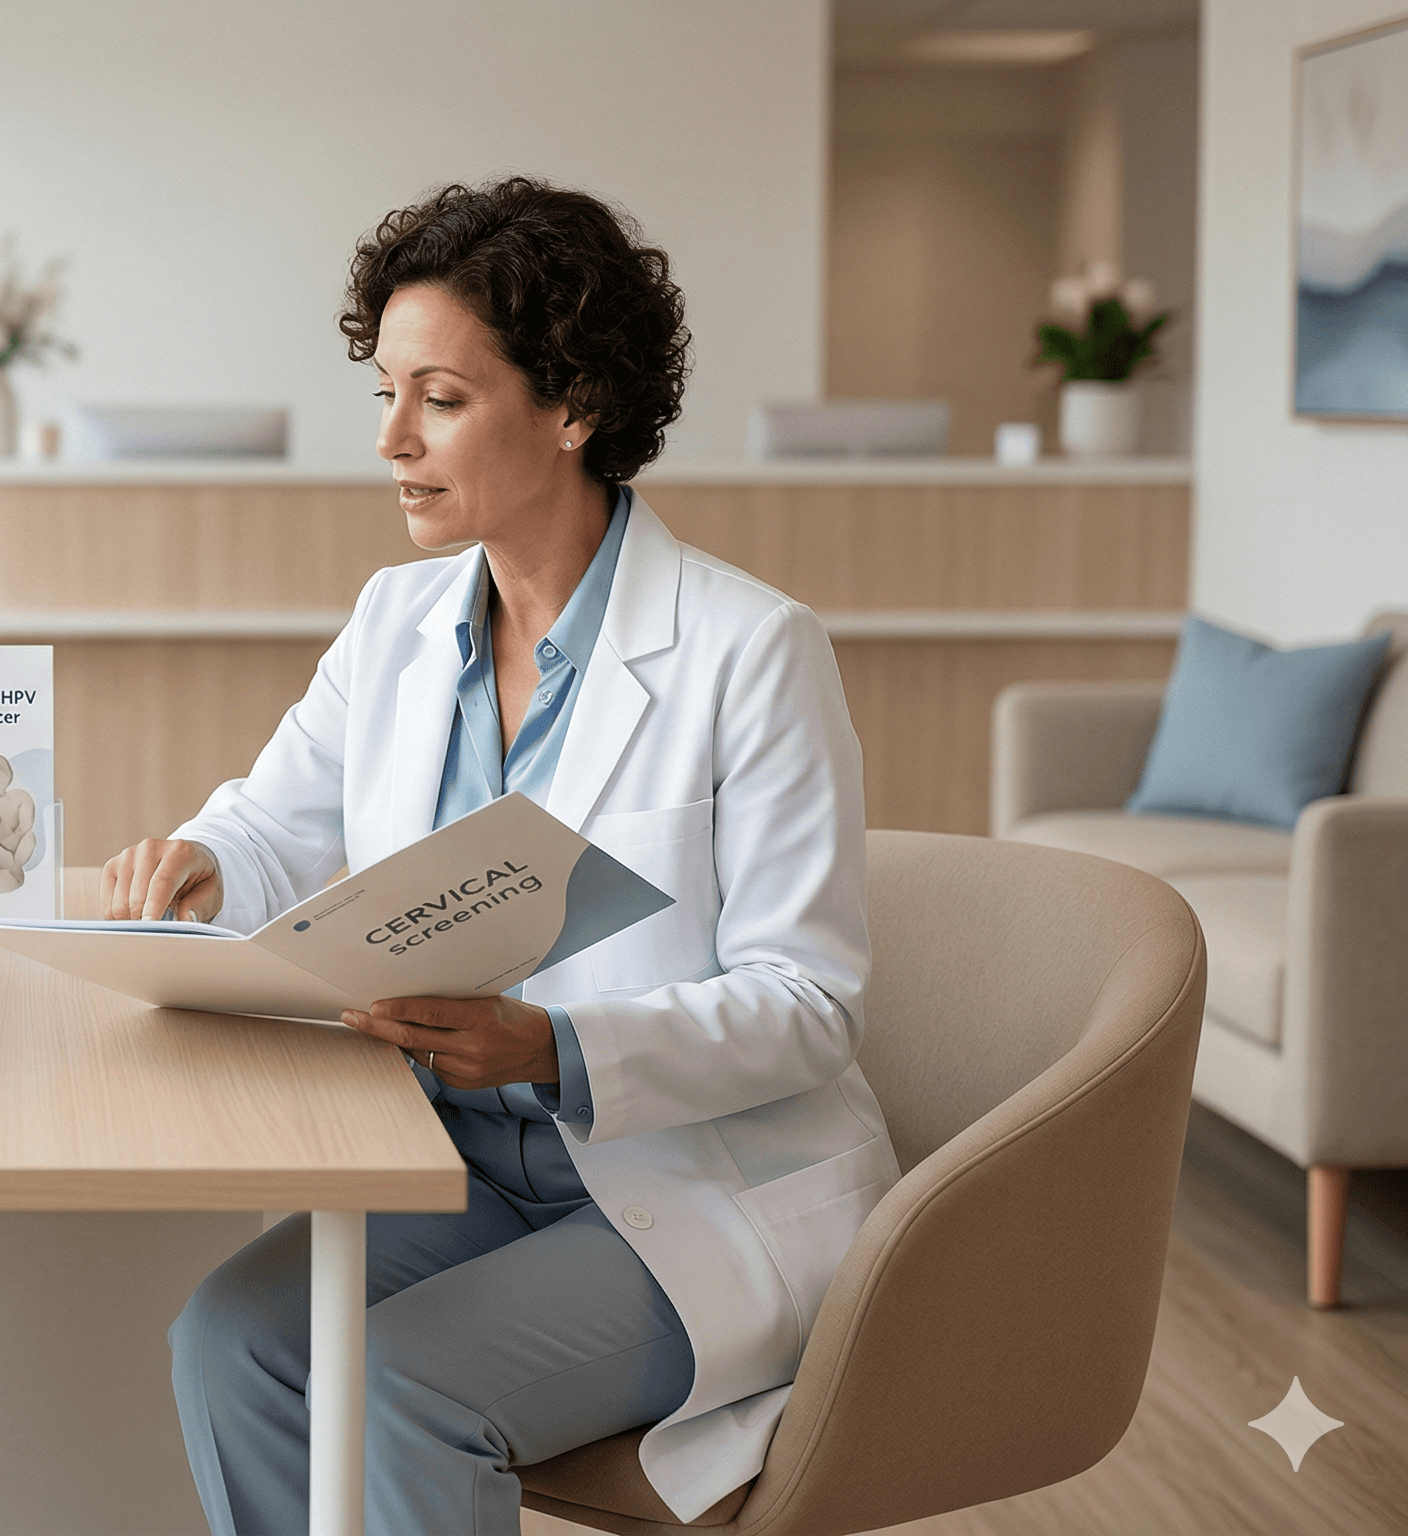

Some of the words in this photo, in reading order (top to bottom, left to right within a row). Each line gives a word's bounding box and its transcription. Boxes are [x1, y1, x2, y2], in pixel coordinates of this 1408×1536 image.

[1, 690, 37, 705] HPV
[365, 860, 529, 945] CERVICAL
[389, 874, 543, 956] screening
